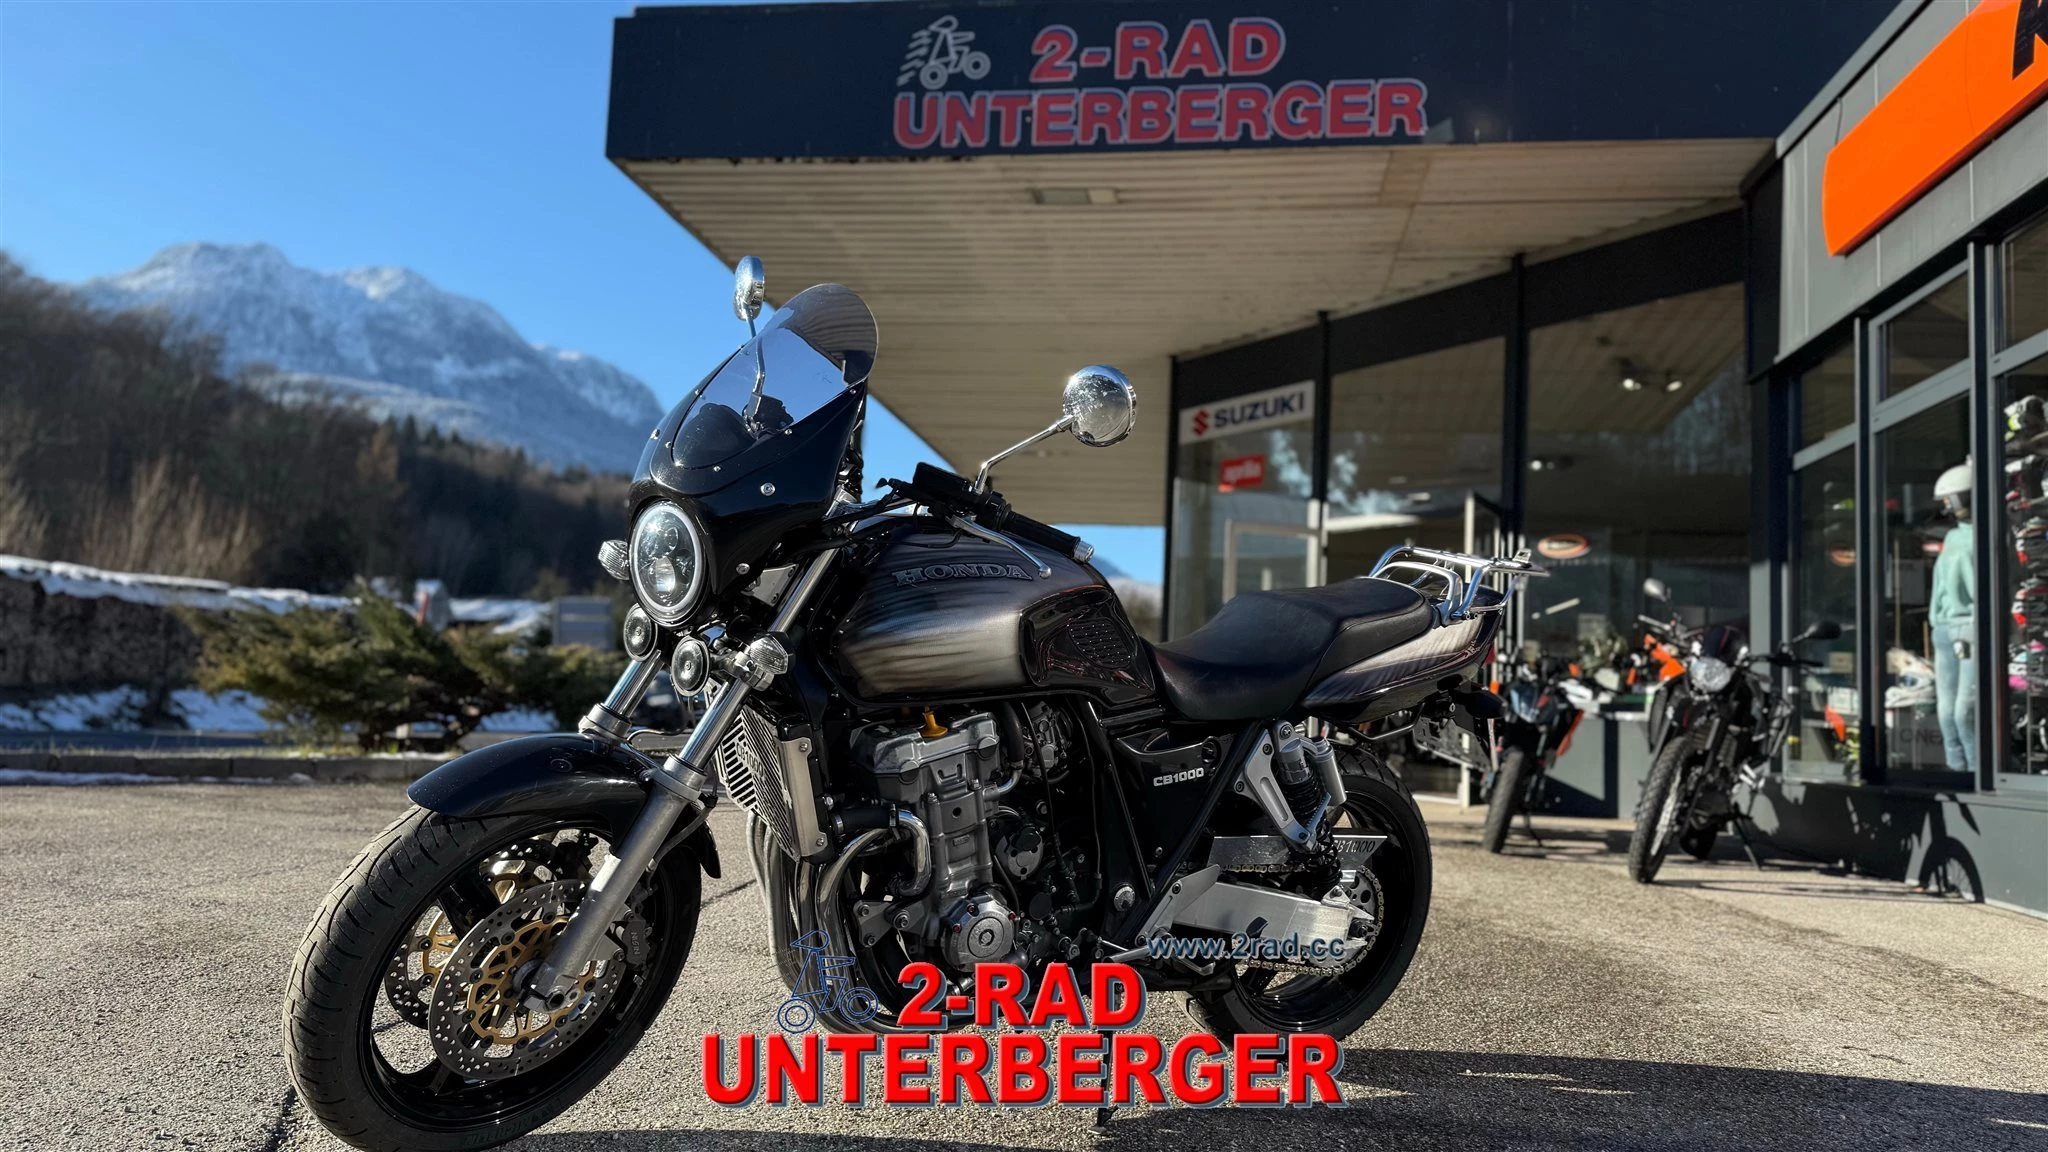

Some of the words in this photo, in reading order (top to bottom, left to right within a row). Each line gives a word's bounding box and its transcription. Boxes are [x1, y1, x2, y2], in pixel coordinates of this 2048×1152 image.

[1029, 18, 1286, 83] 2-RAD
[893, 78, 1428, 149] UNTERBERGER
[1214, 392, 1305, 428] SUZUKI
[892, 563, 1034, 587] HONDA
[1153, 767, 1205, 787] CB1000
